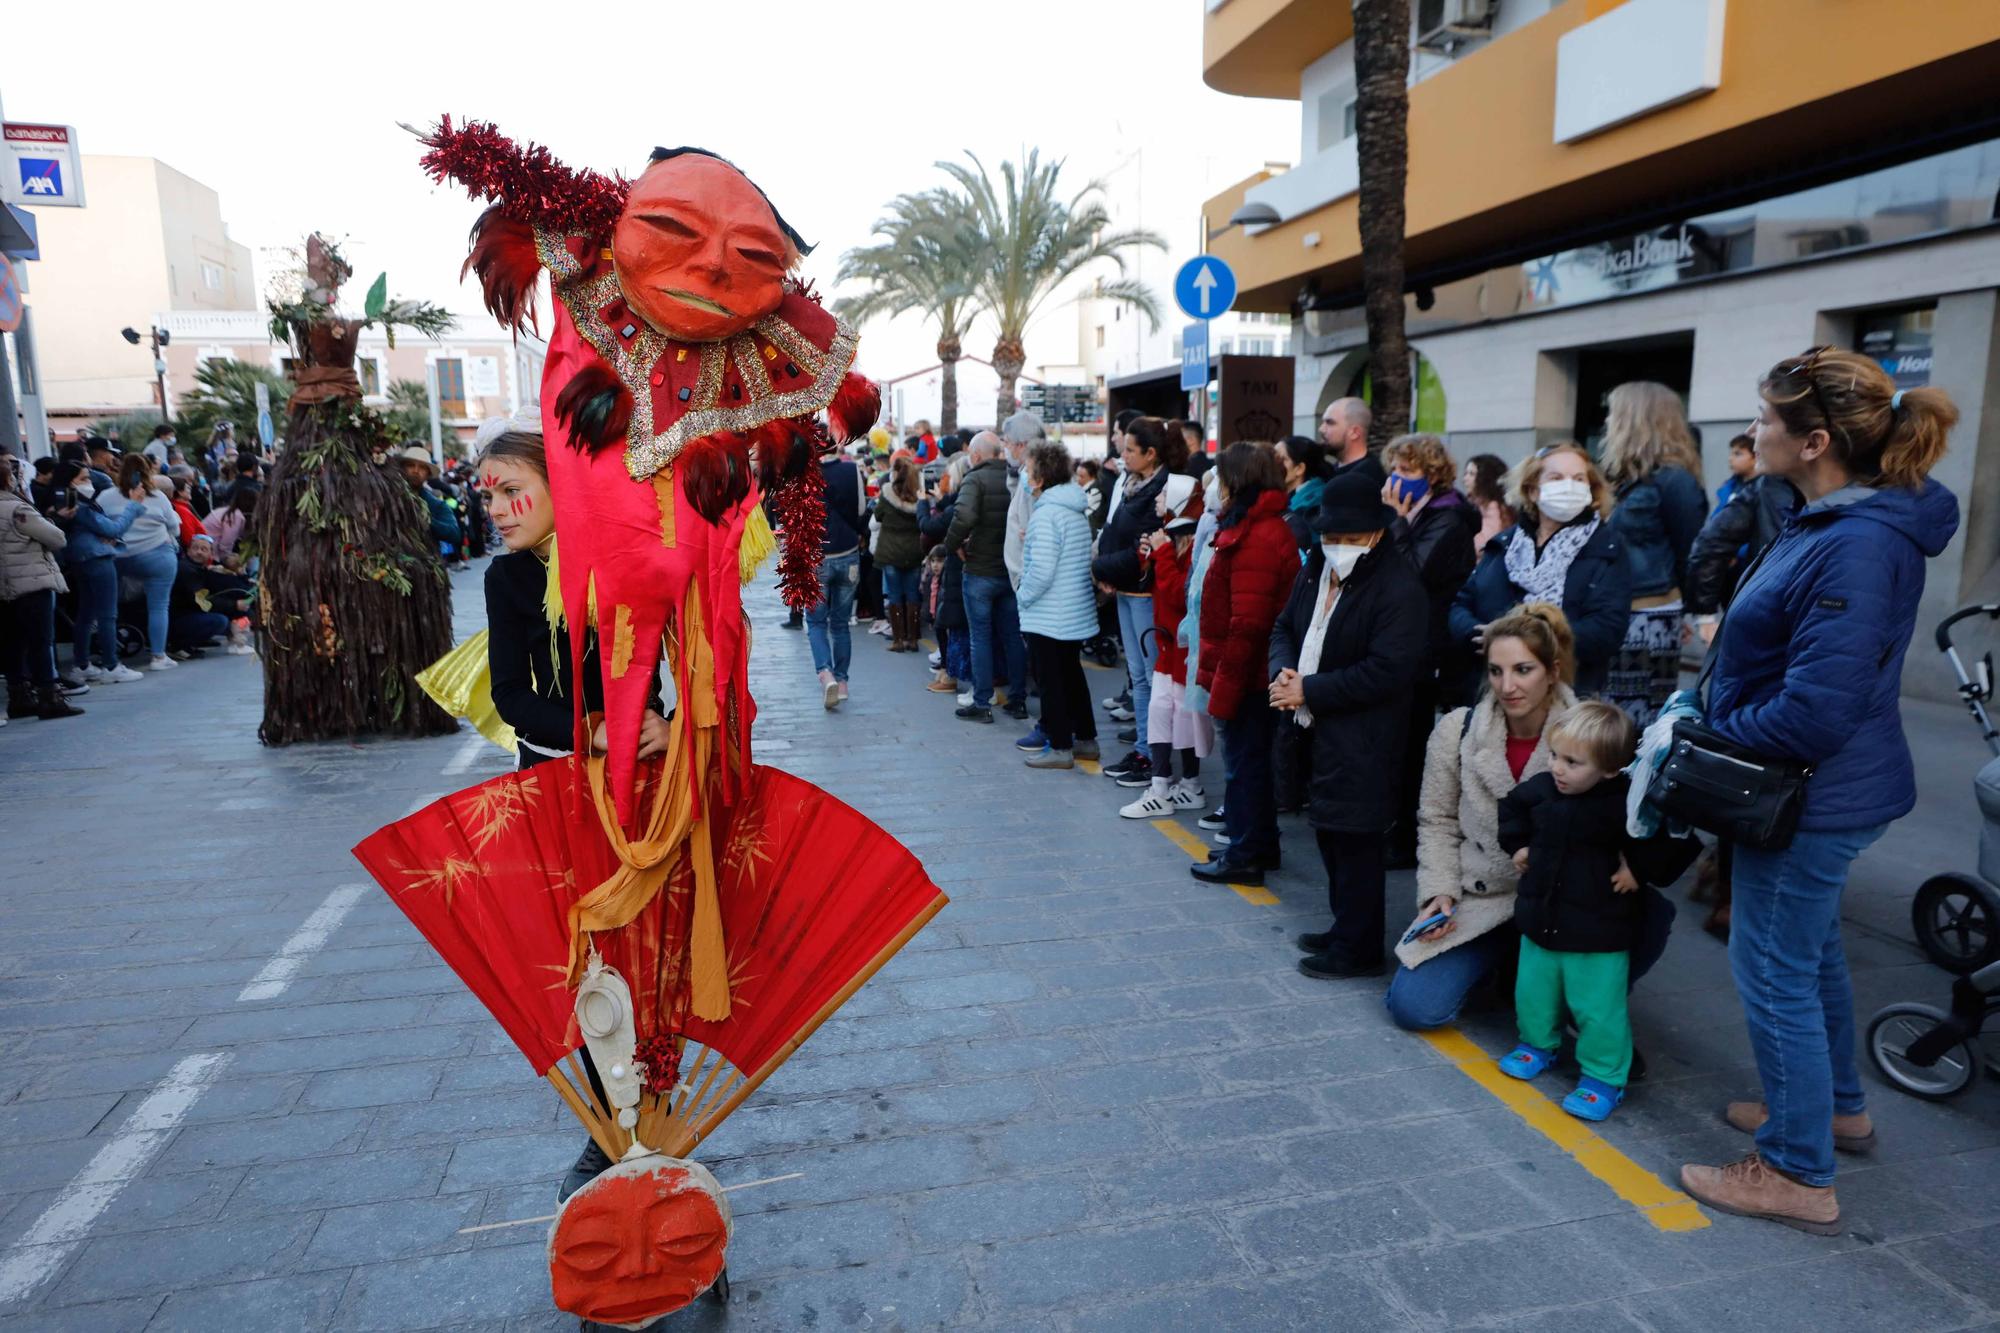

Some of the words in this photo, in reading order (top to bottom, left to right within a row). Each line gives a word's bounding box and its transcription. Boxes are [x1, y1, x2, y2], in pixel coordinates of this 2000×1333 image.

[23, 175, 57, 194] AXA
[1184, 343, 1205, 367] TAXI
[1240, 380, 1279, 396] TAXI
